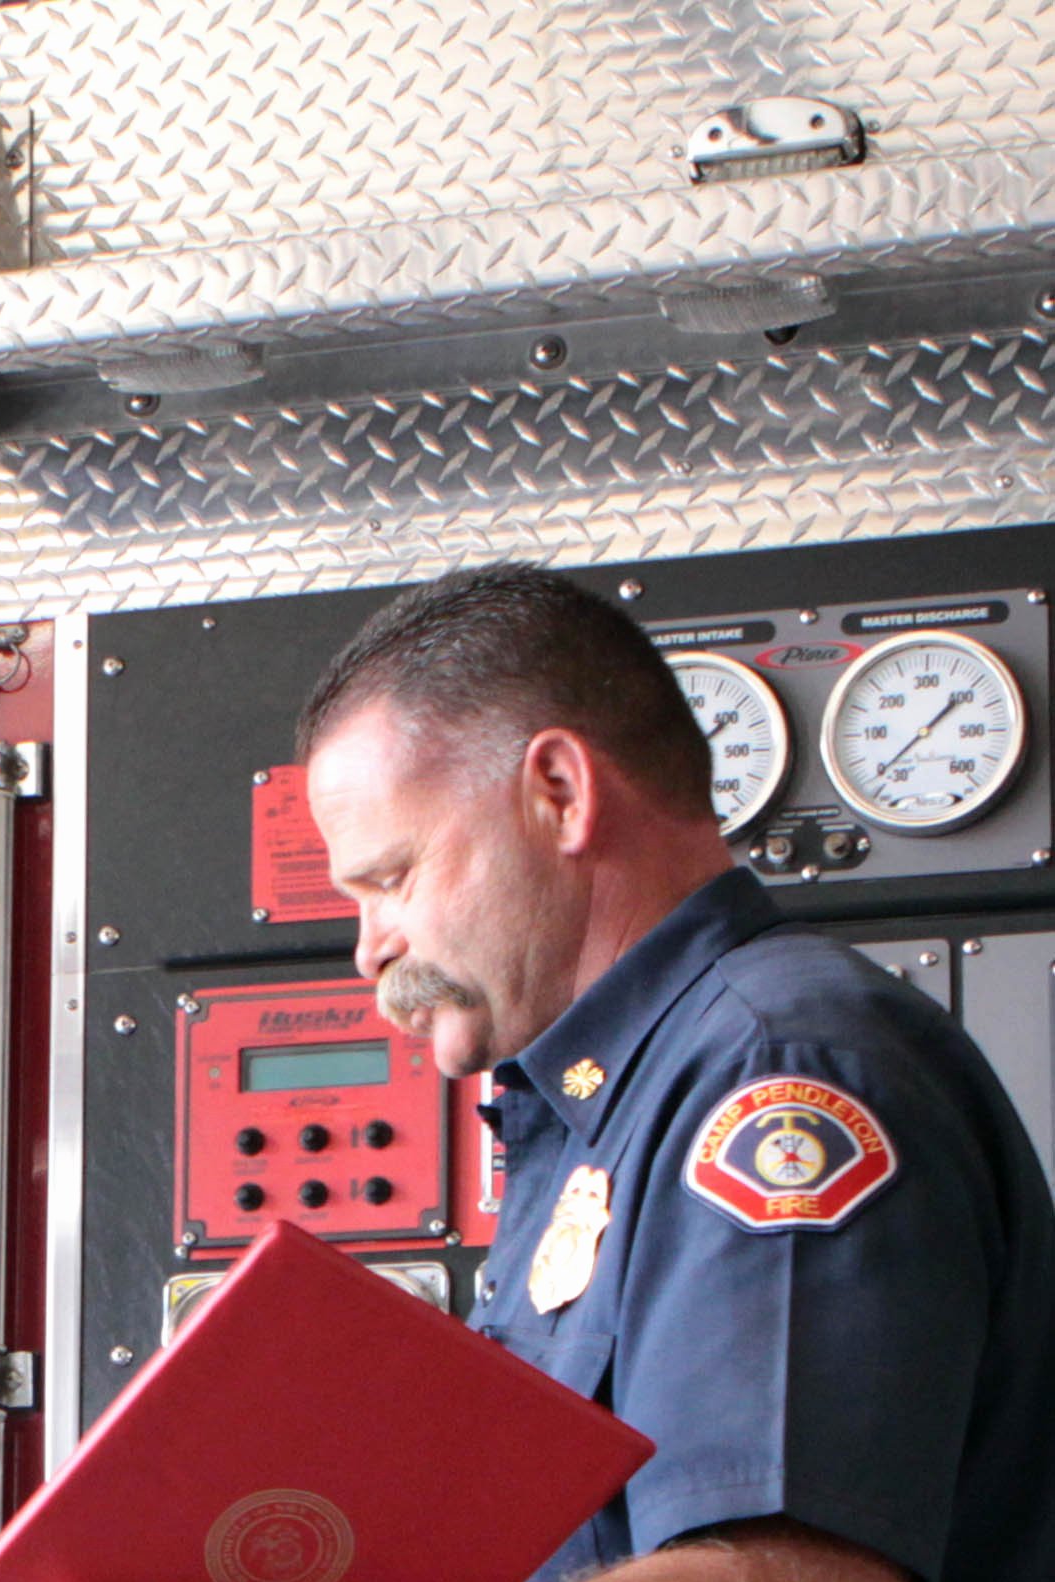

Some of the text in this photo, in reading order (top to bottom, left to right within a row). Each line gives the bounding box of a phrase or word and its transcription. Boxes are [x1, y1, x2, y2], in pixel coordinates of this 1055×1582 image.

[861, 607, 990, 628] MASTER DISCHARGE
[697, 627, 744, 641] INTAKE
[913, 674, 939, 690] 300
[879, 694, 905, 709] 200
[865, 725, 887, 740] 100
[959, 723, 985, 738] 500
[725, 743, 750, 759] 500
[949, 758, 976, 774] 600
[698, 1084, 885, 1164] CAMP PENDLETON
[765, 1196, 821, 1216] FIRE
